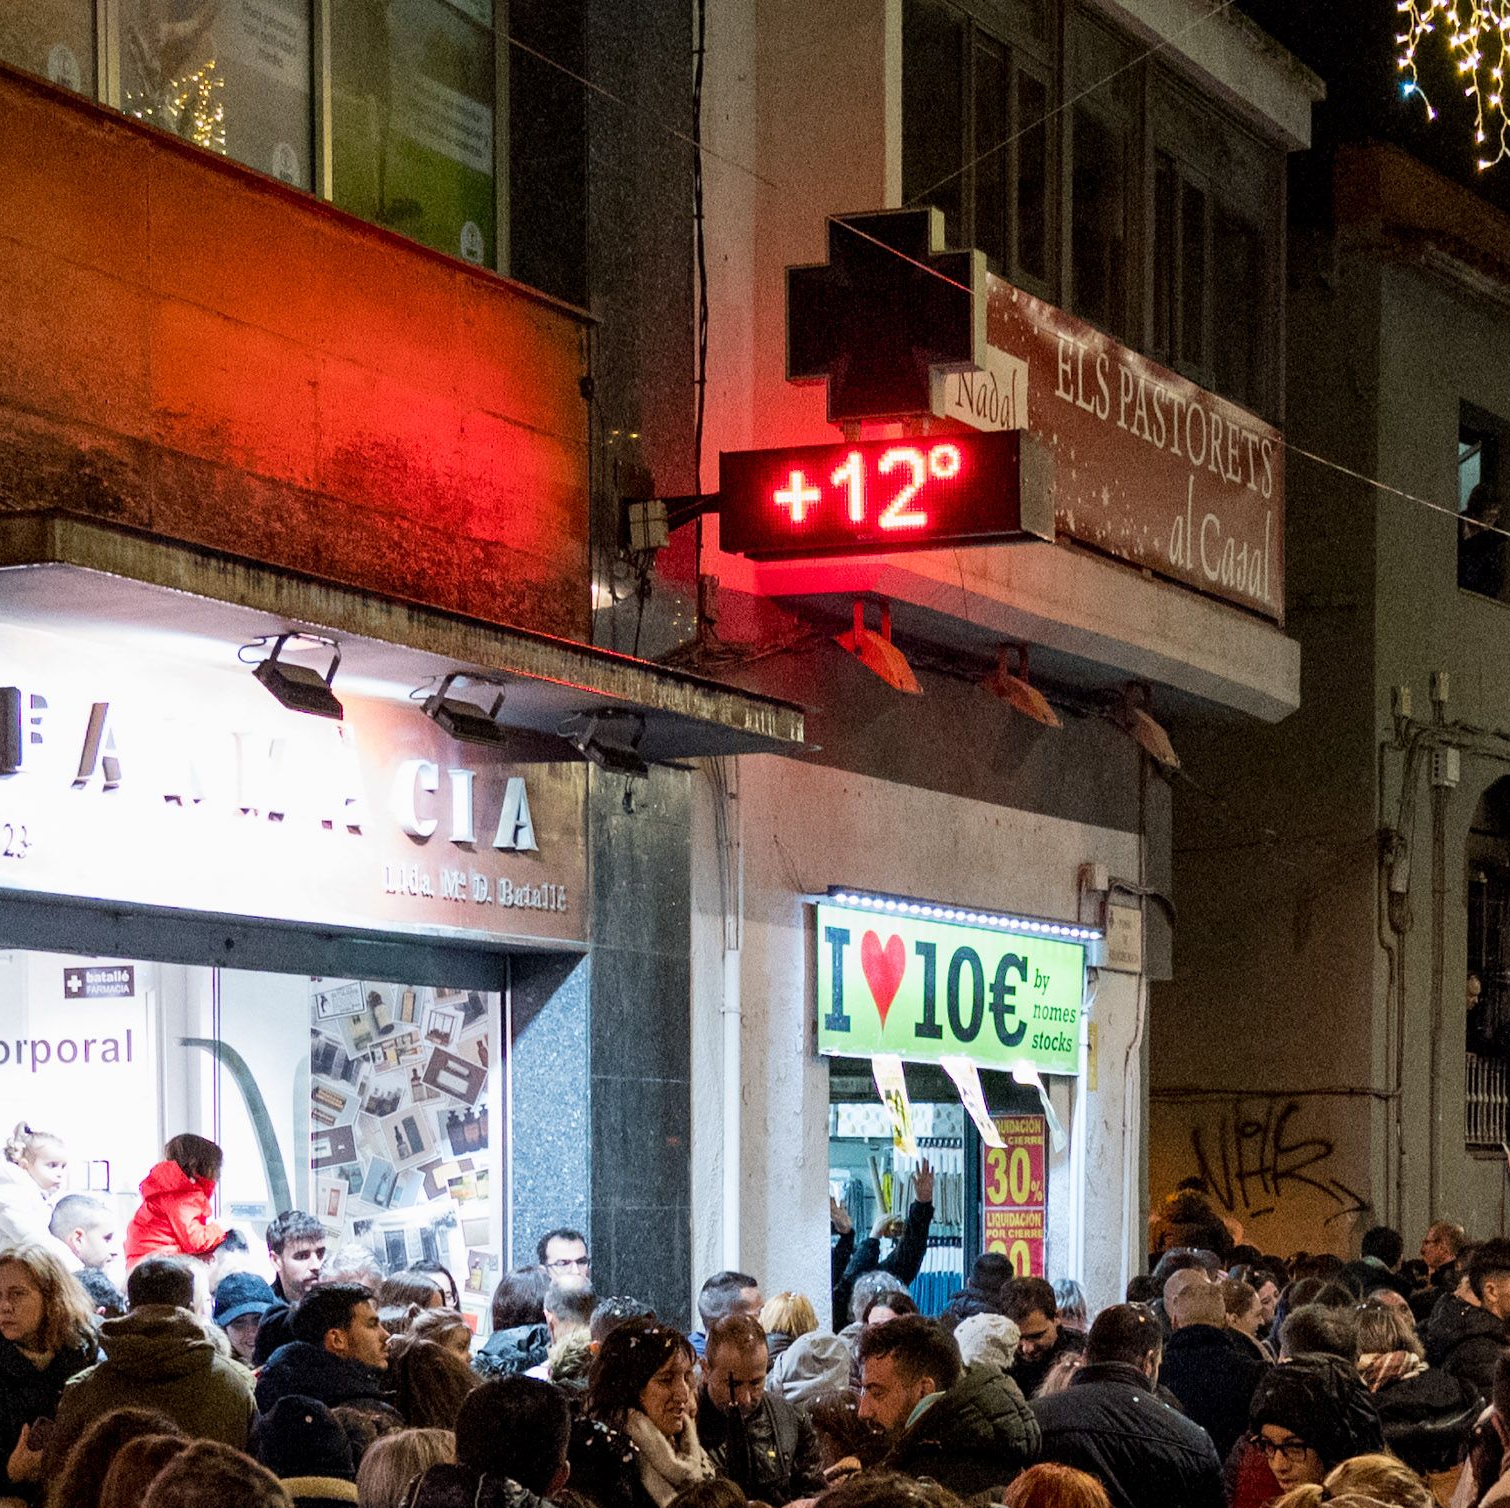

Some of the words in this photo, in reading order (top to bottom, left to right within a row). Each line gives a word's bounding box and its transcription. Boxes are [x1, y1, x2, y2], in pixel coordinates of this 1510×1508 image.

[955, 369, 1017, 430] Nadal
[1055, 331, 1110, 421] ELS
[1117, 364, 1273, 499] PASTORETS
[1169, 474, 1195, 571] al
[1200, 510, 1272, 601] Casal
[86, 983, 130, 994] FARMACIA
[825, 926, 851, 1033] I
[915, 940, 1028, 1047] 10€
[1034, 968, 1050, 995] by
[1033, 1003, 1077, 1024] nomes
[1032, 1031, 1073, 1053] stocks
[986, 1210, 1041, 1227] LIQUIDACIÓN
[986, 1228, 1006, 1238] POR
[1008, 1228, 1043, 1238] CIERRE
